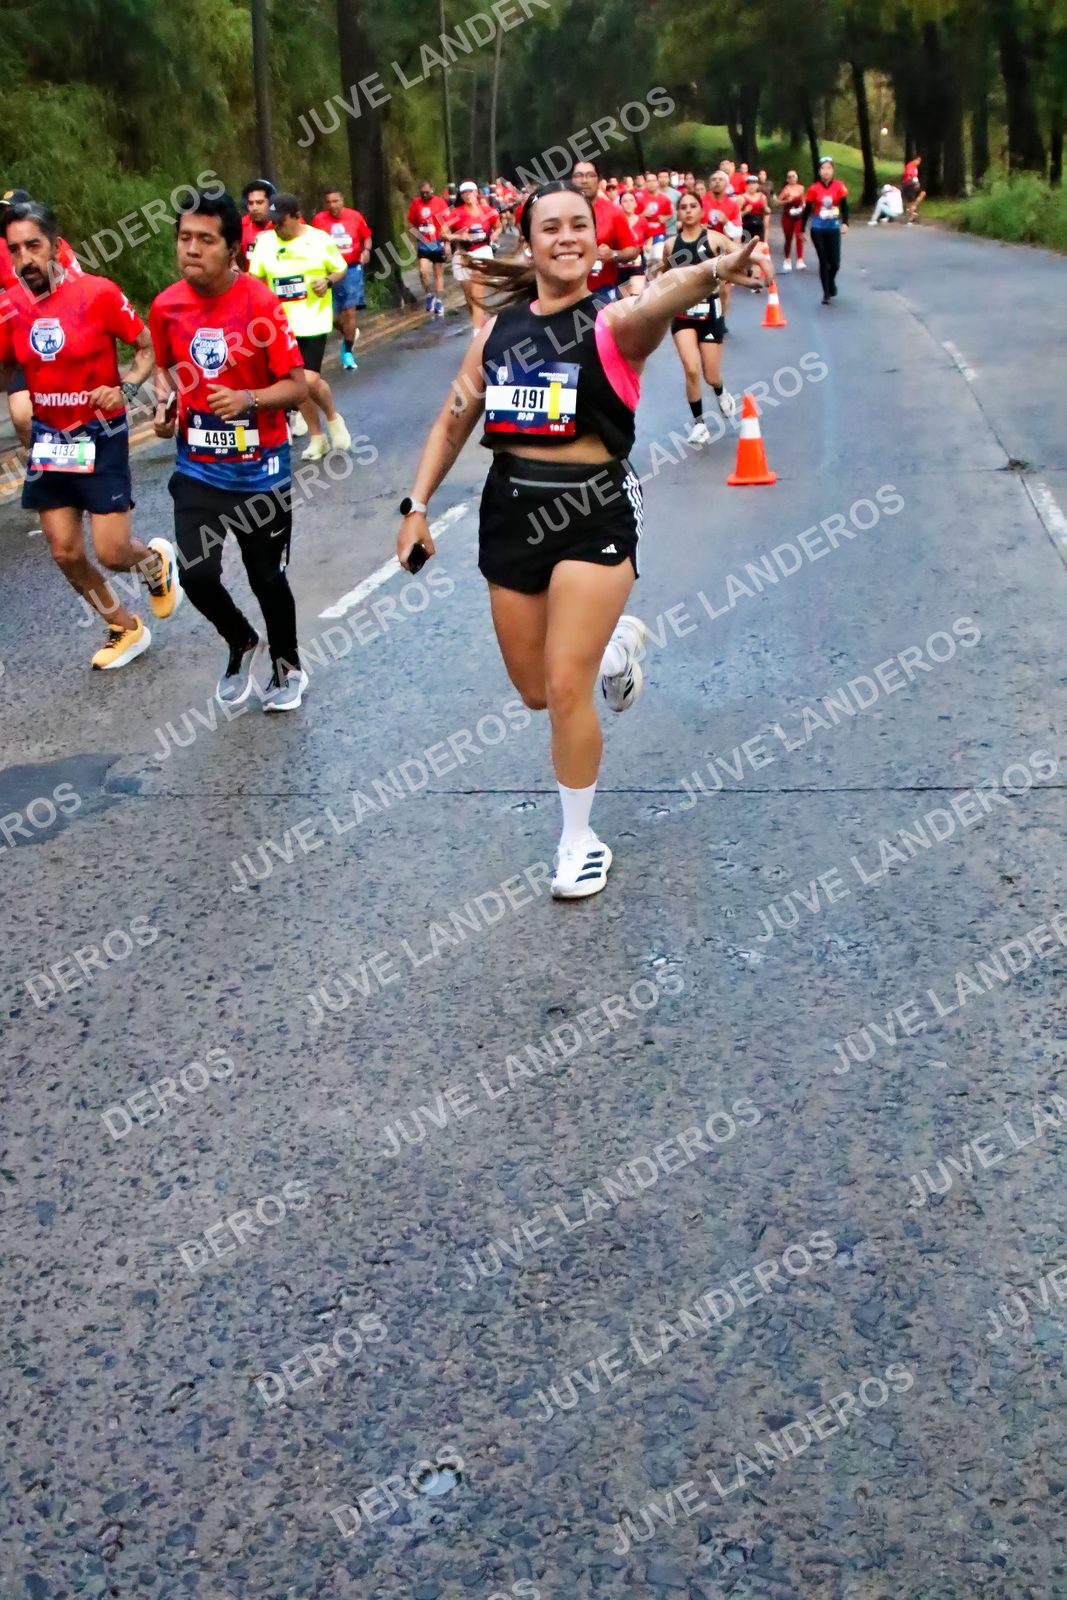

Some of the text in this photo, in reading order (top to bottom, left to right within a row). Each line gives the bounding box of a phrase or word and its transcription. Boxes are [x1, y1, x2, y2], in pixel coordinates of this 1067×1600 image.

[511, 388, 545, 409] 4191
[549, 423, 566, 432] 10K
[204, 431, 236, 446] 4493
[51, 444, 76, 457] 4132
